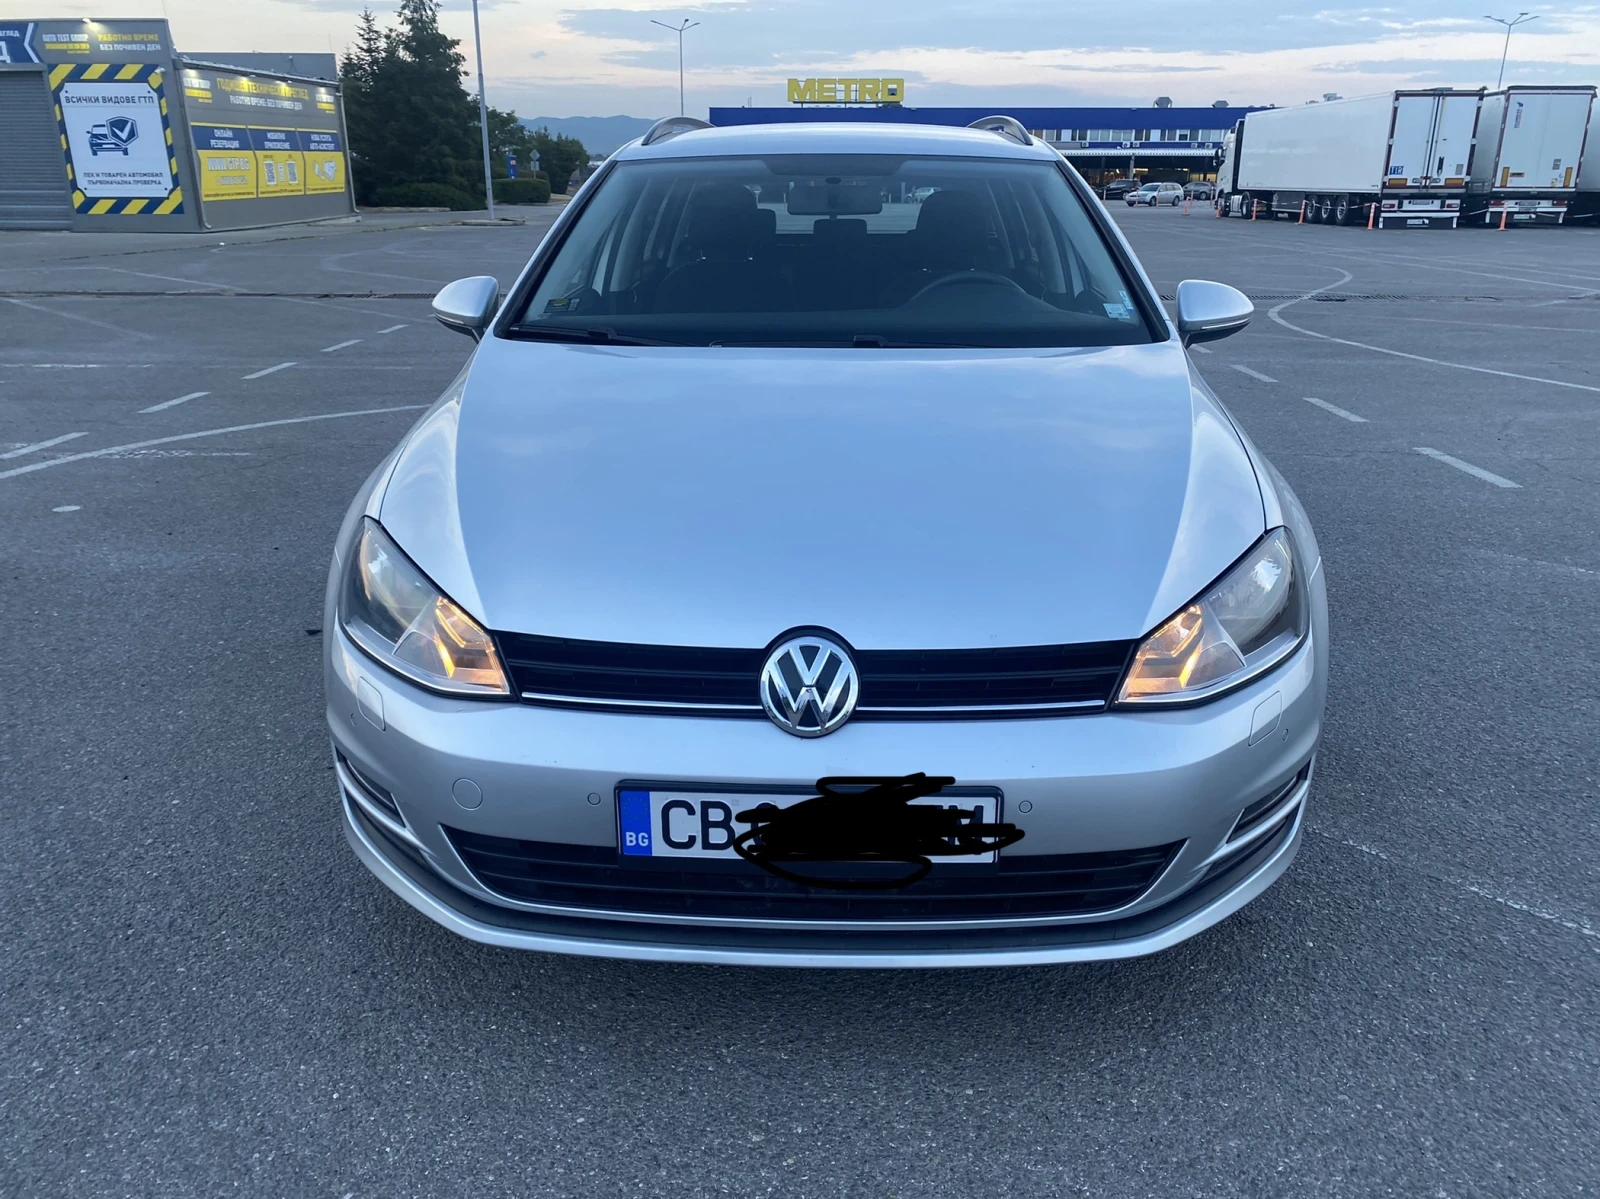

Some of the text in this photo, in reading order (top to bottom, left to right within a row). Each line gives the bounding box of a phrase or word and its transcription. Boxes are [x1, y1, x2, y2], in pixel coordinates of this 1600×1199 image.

[100, 43, 113, 51] БЕЗ
[146, 44, 161, 52] ДЕН
[787, 78, 904, 102] METRO
[65, 96, 154, 104] ВСИЧКИ ВИДОВЕ ГТП
[1390, 166, 1403, 175] TIR
[625, 831, 649, 847] BG
